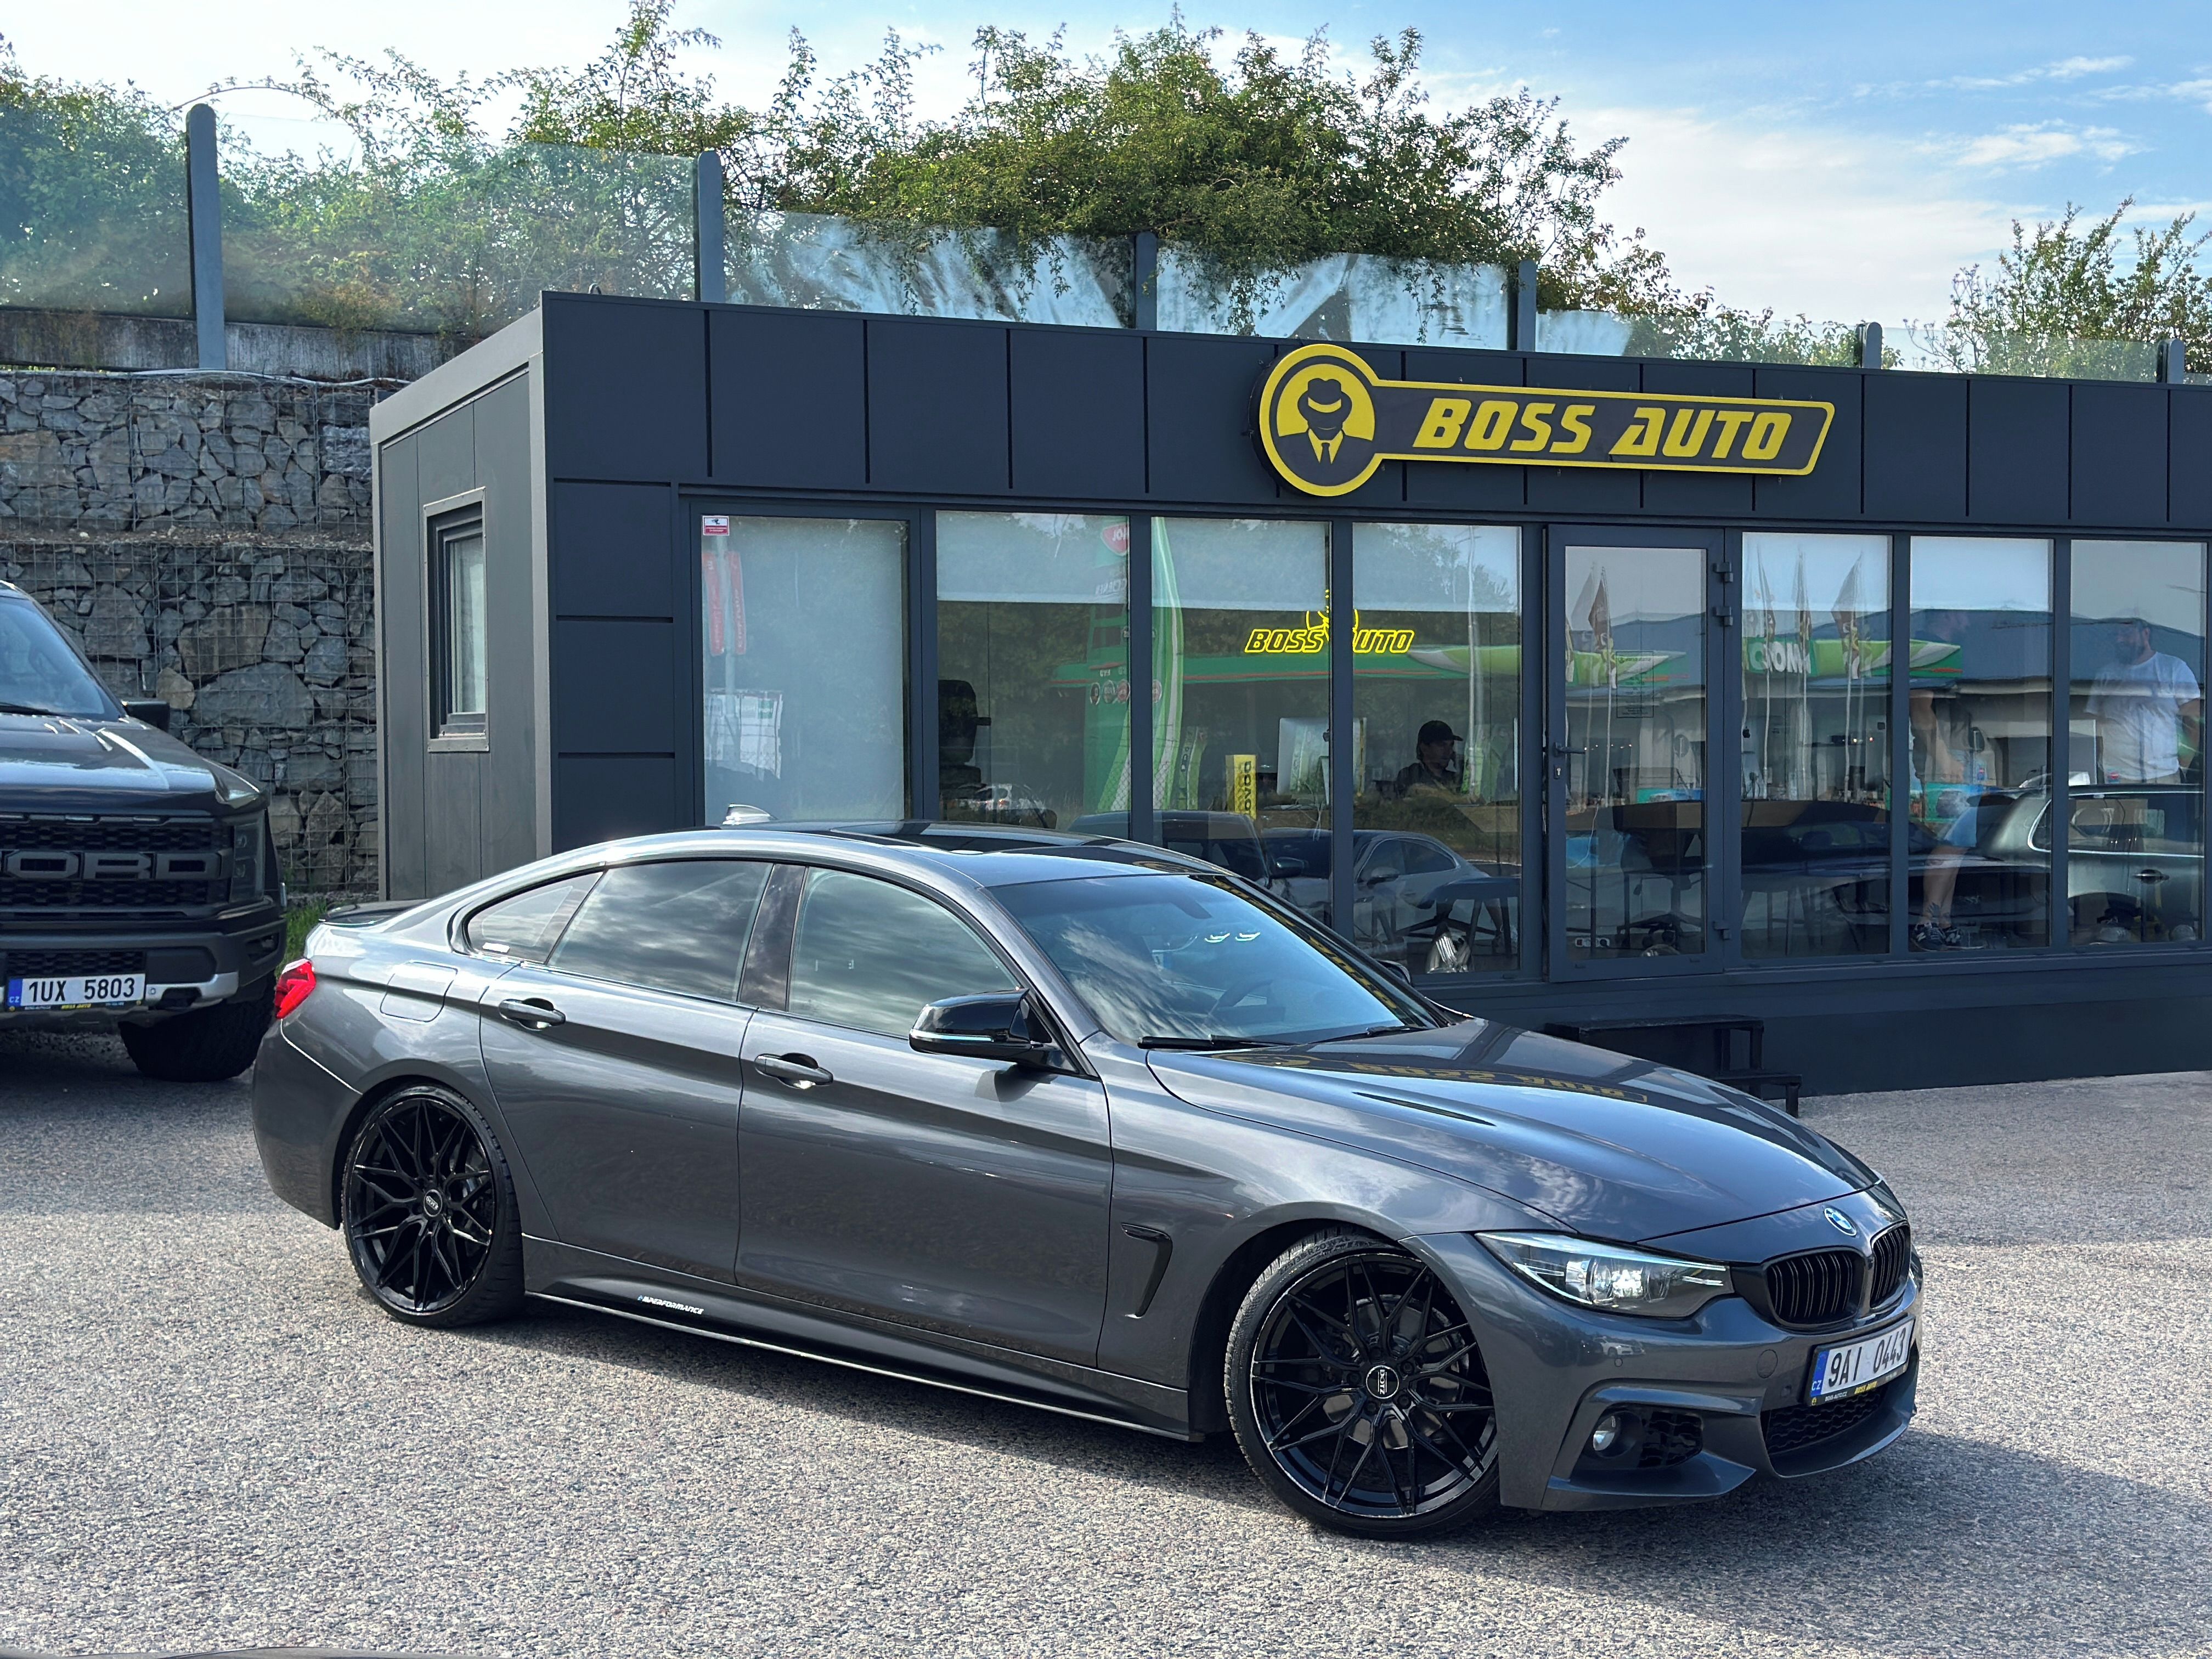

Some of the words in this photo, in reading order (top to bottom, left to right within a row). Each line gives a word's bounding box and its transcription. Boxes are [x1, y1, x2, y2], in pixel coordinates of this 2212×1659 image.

[1413, 398, 1595, 453] BOSS
[1610, 407, 1792, 460] AUTO
[1245, 629, 1324, 653] BOSS
[1353, 629, 1414, 653] UTO
[0, 851, 222, 879] ORD
[29, 980, 66, 1002] 1UX
[84, 978, 134, 1000] 5803
[1812, 1380, 1821, 1390] CZ
[1874, 1327, 1906, 1374] 0443
